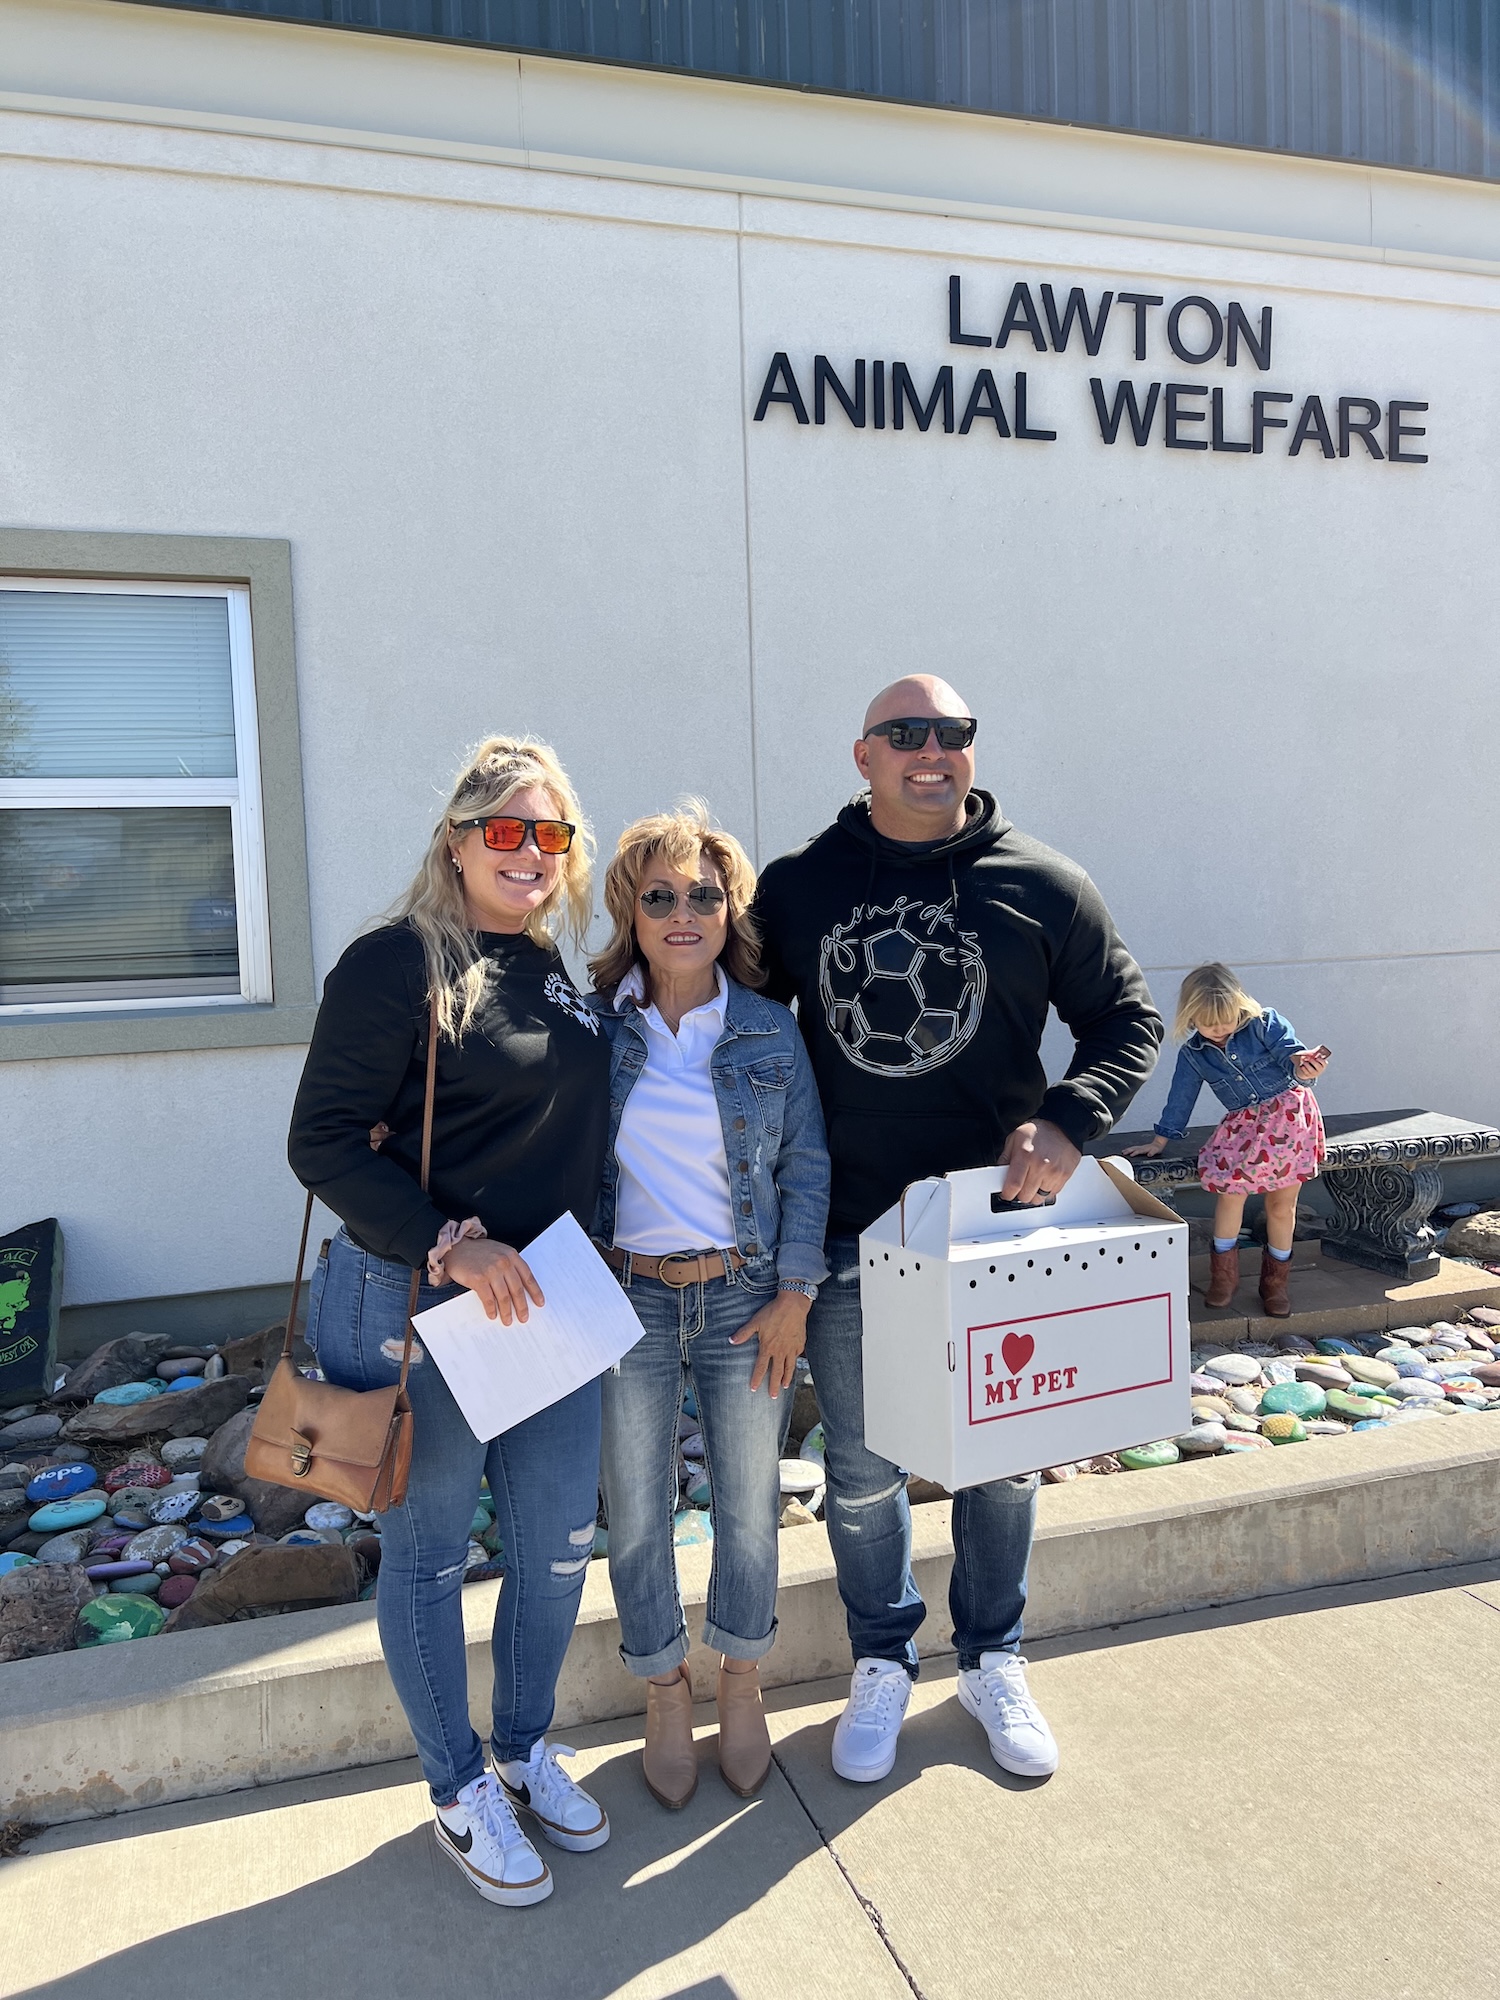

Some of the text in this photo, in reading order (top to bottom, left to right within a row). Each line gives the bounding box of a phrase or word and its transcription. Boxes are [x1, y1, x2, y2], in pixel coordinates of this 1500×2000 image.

[949, 275, 1272, 370] LAWTON
[753, 352, 1429, 464] ANIMAL WELFARE
[984, 1353, 994, 1376] I
[985, 1366, 1078, 1406] MY PET
